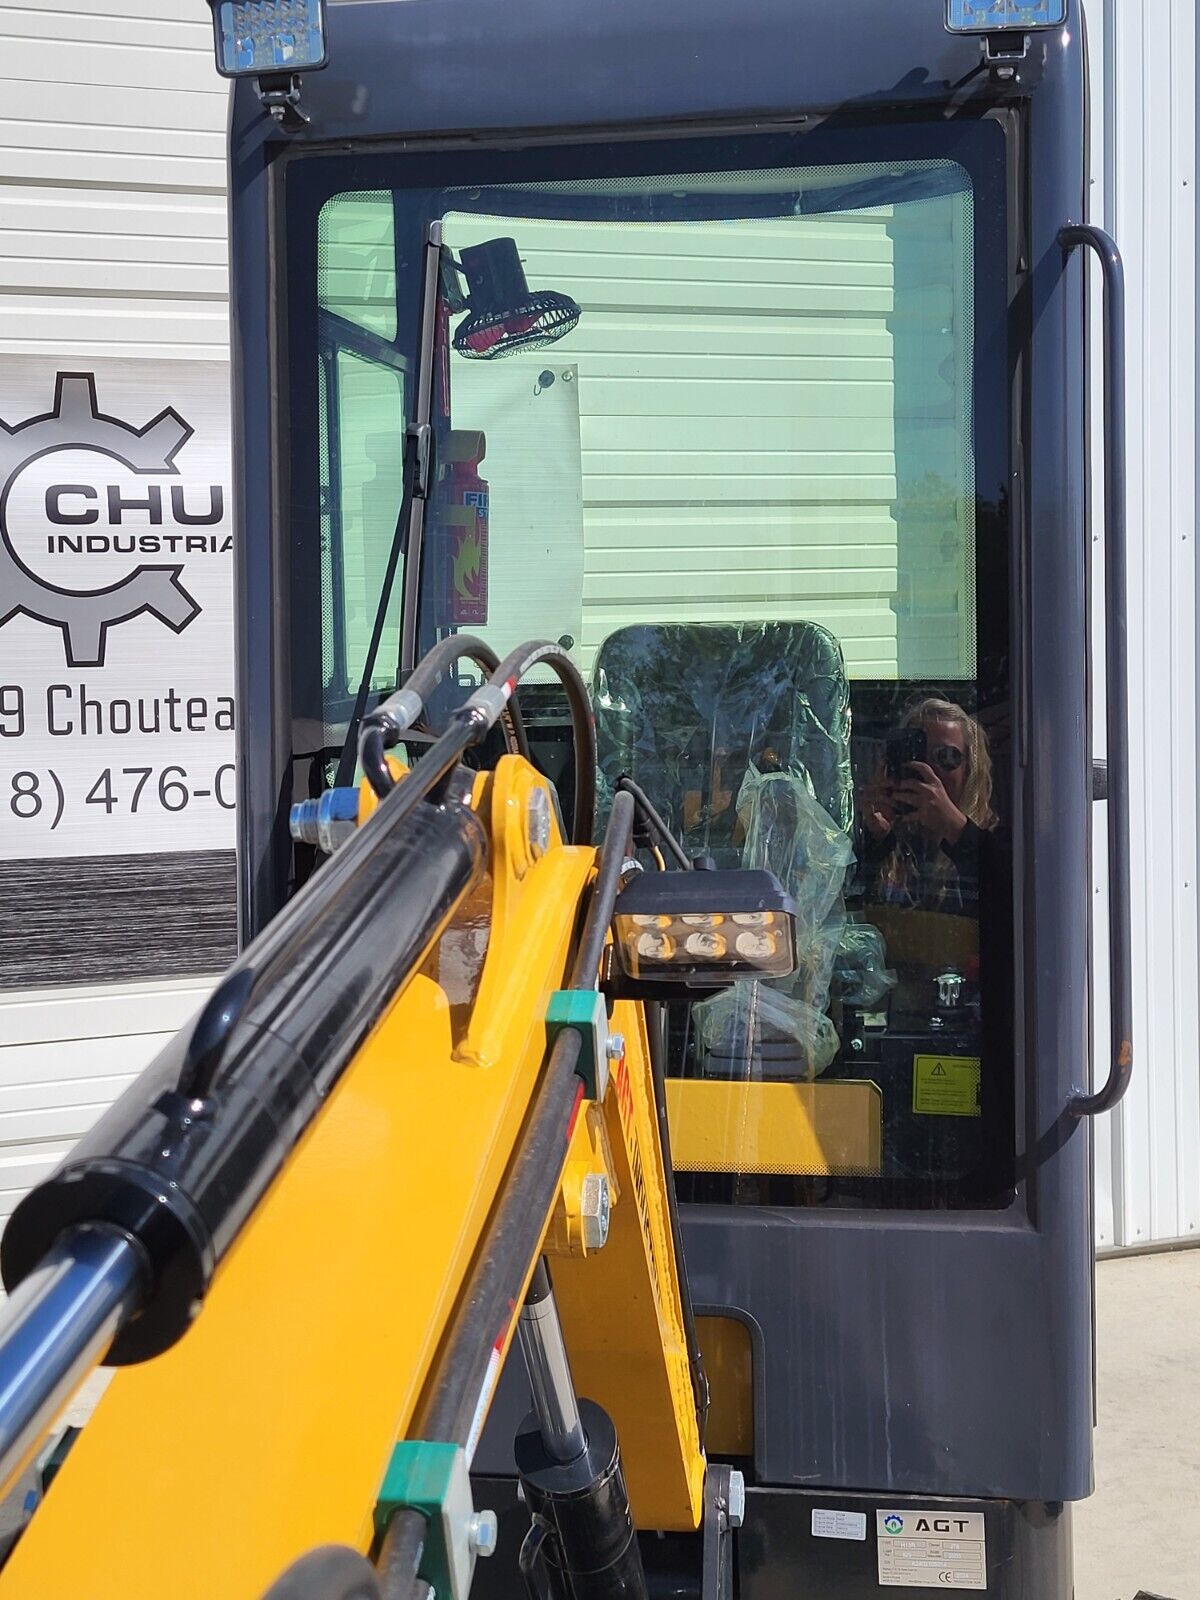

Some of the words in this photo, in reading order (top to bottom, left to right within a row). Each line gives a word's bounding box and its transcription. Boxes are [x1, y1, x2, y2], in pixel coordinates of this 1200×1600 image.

[45, 484, 224, 526] CHU
[0, 685, 25, 738] 9
[46, 683, 235, 736] Choutea
[10, 770, 65, 830] 8)
[915, 1518, 969, 1533] AGT
